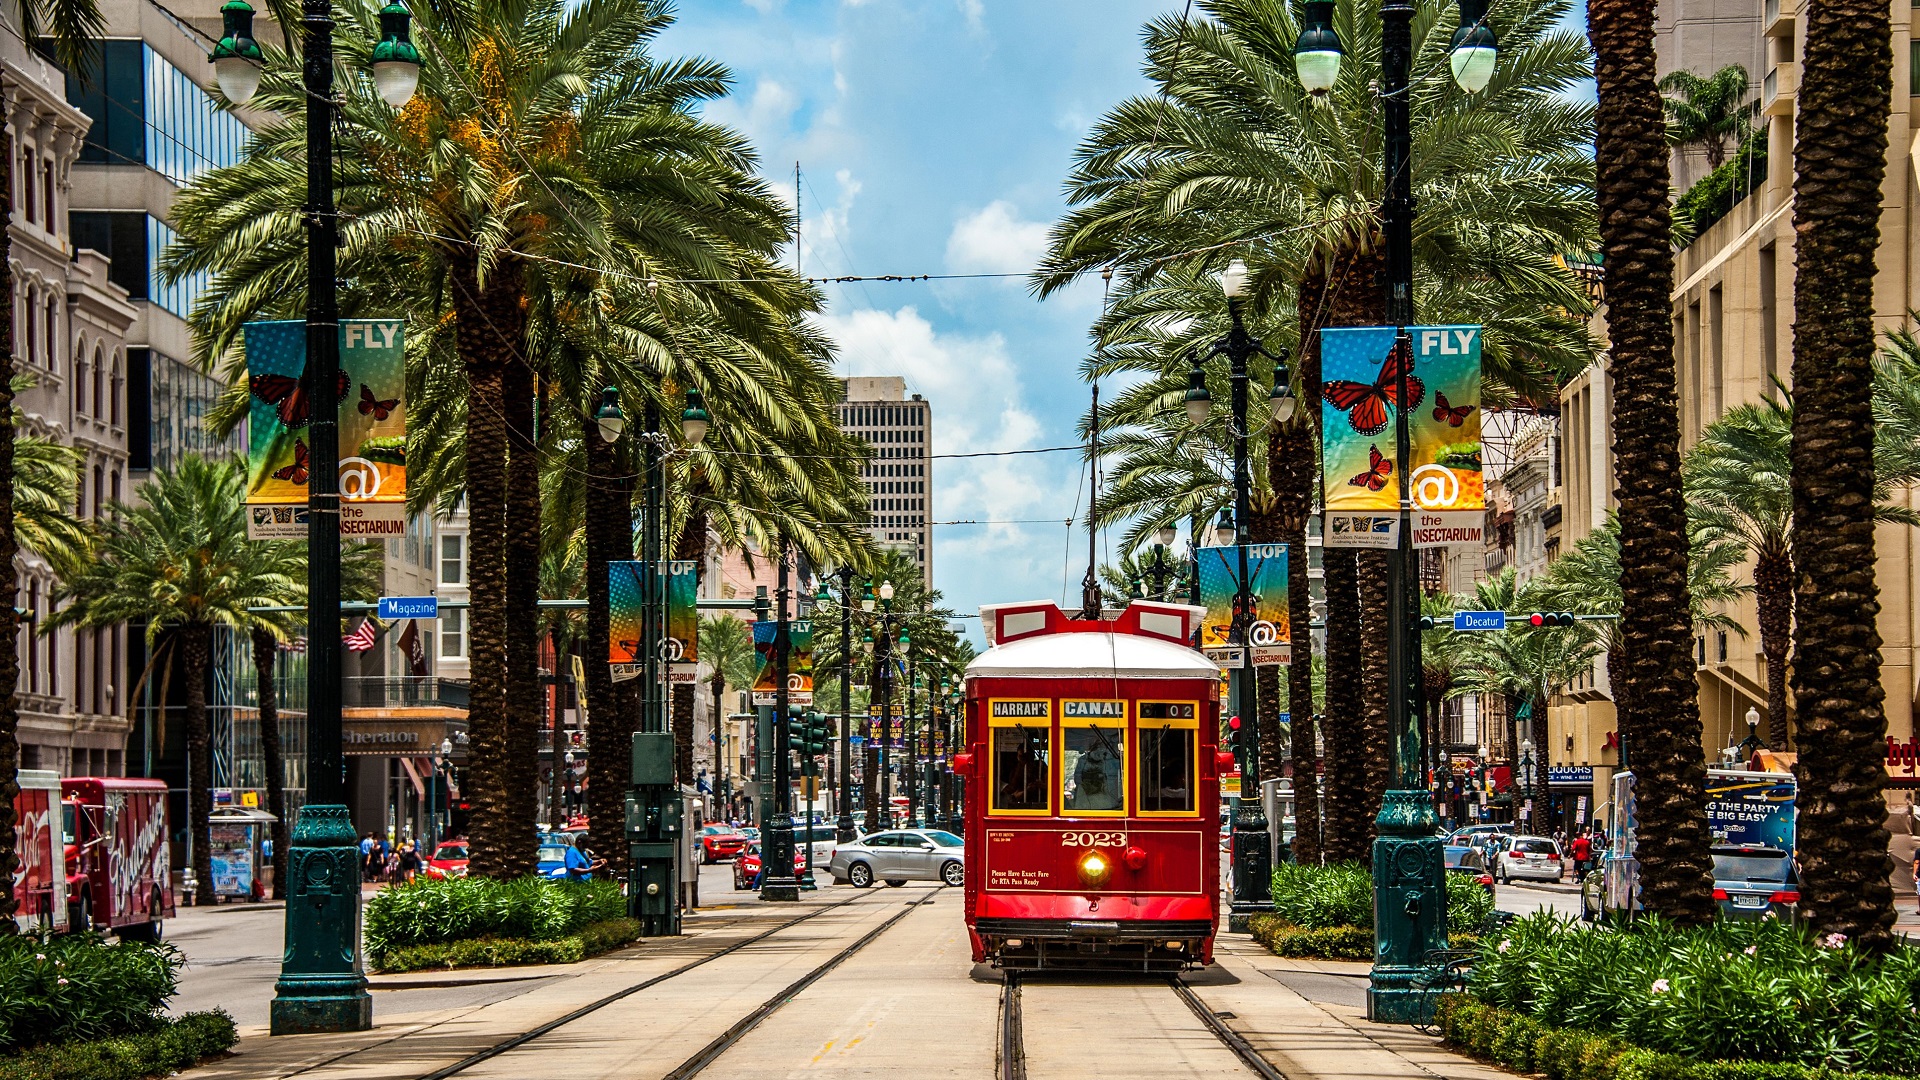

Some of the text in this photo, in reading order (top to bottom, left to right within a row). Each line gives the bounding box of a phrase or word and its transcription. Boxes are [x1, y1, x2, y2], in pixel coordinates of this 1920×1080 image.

[345, 323, 400, 349] FLY
[1421, 329, 1477, 356] FLY
[341, 506, 363, 518] the
[338, 519, 404, 535] NSECTARIUM
[1420, 515, 1442, 526] the
[1413, 528, 1481, 544] INSECTARIUM
[1248, 545, 1287, 559] HOP
[388, 601, 435, 616] Magazine
[790, 622, 811, 633] FLY
[1465, 615, 1499, 627] Decatur
[1252, 655, 1290, 665] INSECTARIUM
[994, 702, 1048, 716] HARRAH'S
[1065, 702, 1123, 715] CANAL
[341, 729, 419, 744] Sheraton
[1548, 766, 1592, 774] LIQUORS
[1719, 802, 1742, 812] THE
[1743, 803, 1780, 814] PARTY
[1717, 811, 1736, 820] BIG
[1738, 812, 1768, 822] EASY
[1061, 832, 1127, 847] 2023
[1023, 878, 1040, 887] Ready
